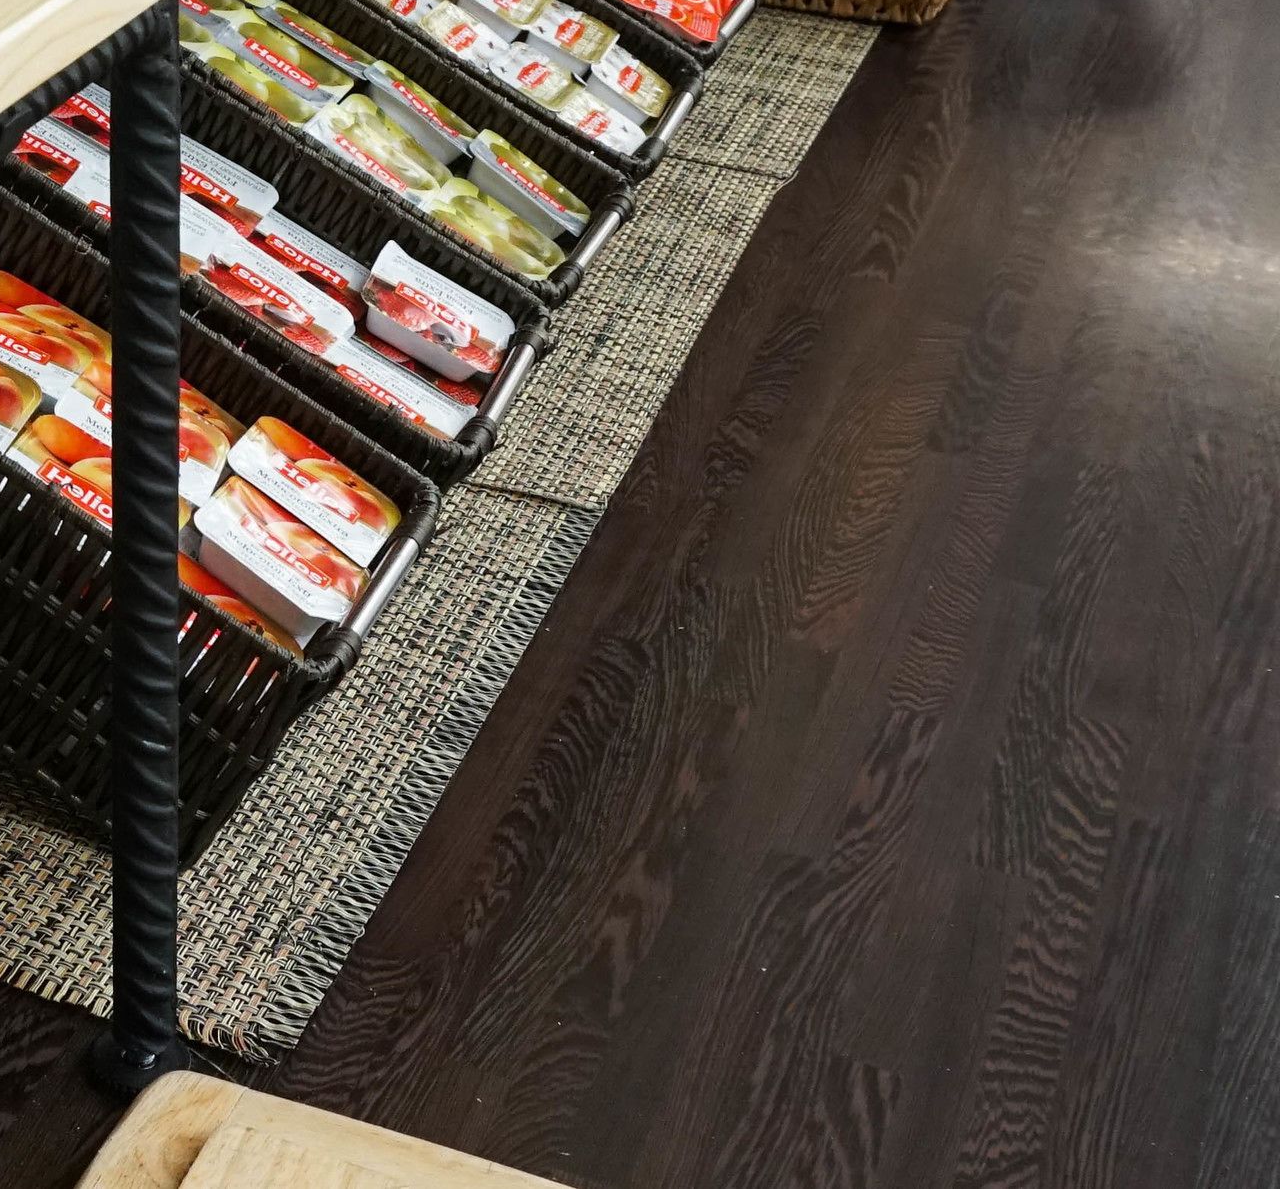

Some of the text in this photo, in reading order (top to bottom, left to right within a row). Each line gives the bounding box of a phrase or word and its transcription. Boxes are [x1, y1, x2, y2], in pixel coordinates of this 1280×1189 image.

[246, 41, 314, 85] Helios
[501, 158, 563, 210] Helios
[271, 237, 342, 285] Helios
[47, 466, 112, 519] Helio
